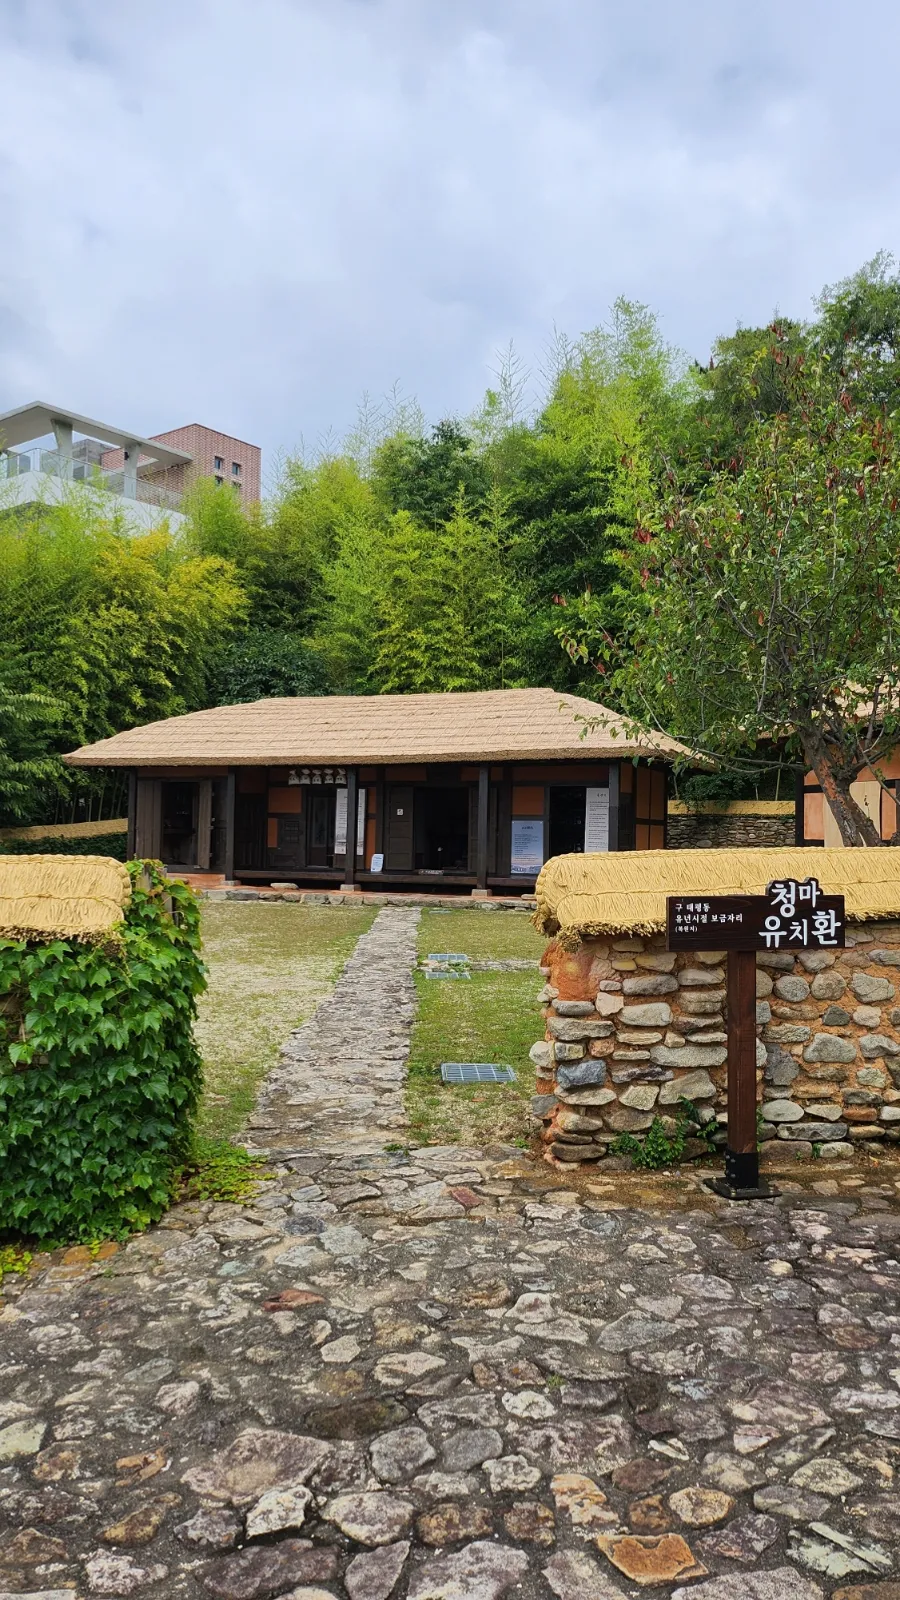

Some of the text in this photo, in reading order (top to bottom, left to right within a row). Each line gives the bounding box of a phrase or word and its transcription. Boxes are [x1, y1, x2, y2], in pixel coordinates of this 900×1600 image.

[675, 902, 711, 912] 구 태평동
[770, 880, 821, 918] 청마
[675, 913, 743, 924] 유년시절 보금자리
[758, 909, 842, 948] 유치환
